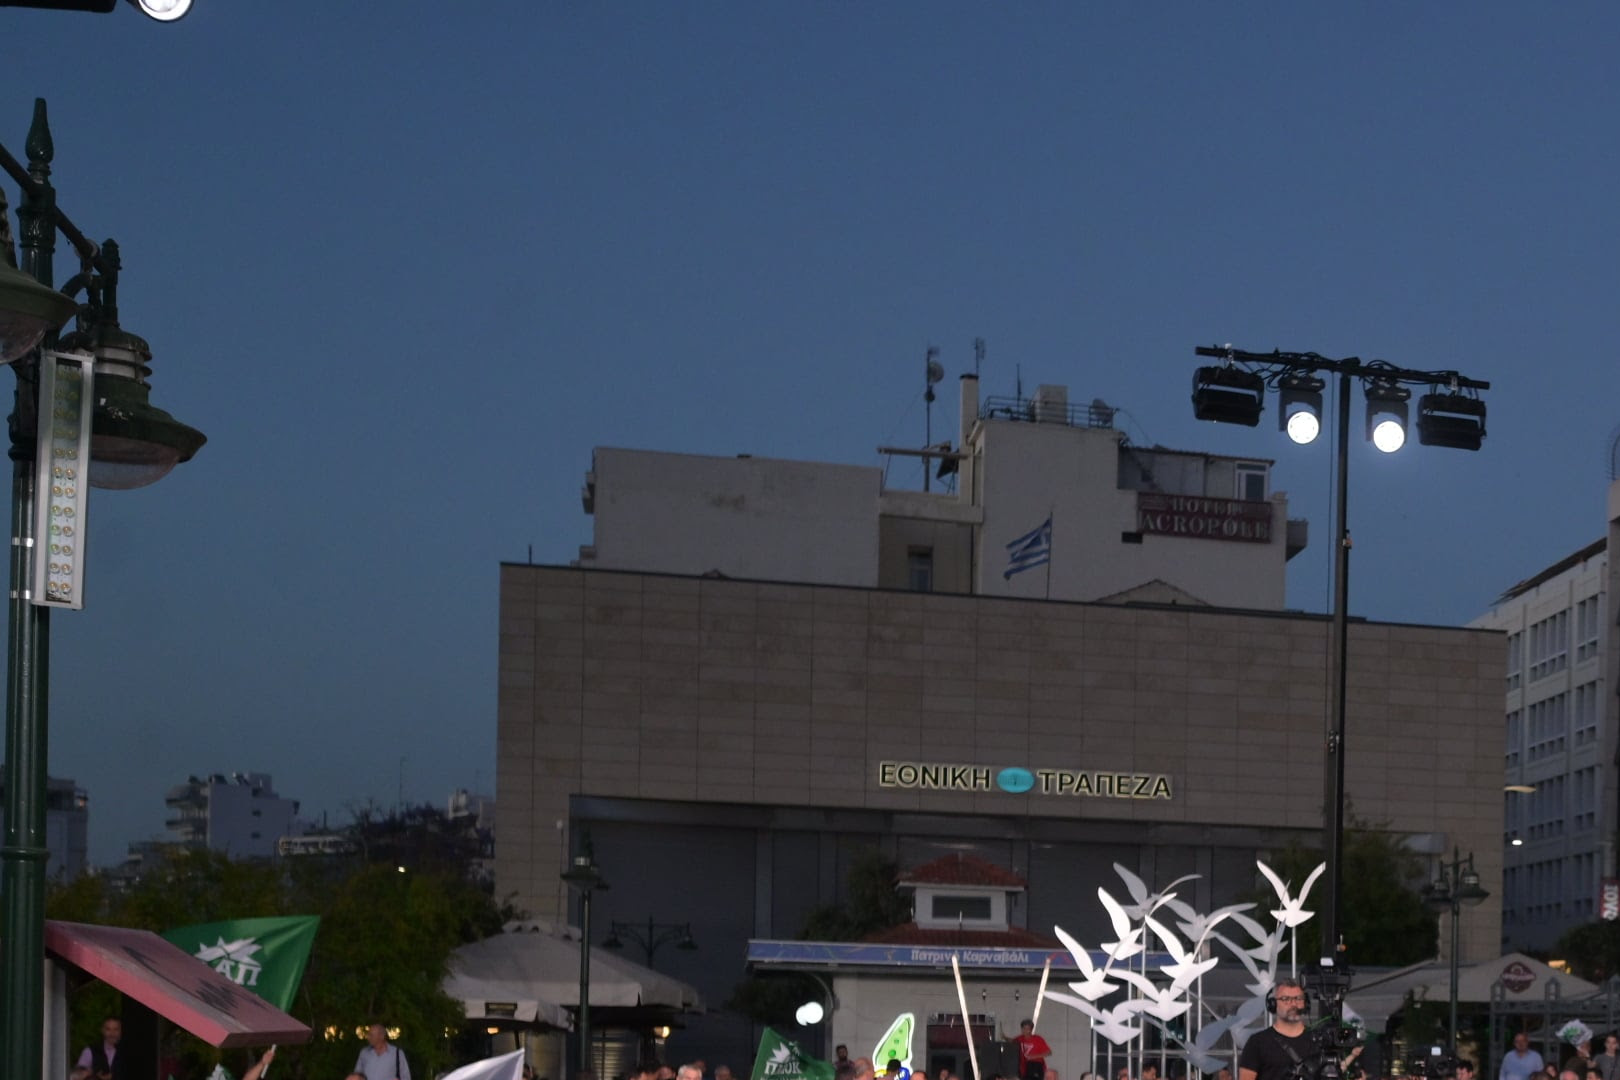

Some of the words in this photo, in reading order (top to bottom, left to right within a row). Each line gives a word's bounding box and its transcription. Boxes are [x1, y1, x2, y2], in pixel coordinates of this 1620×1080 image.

[879, 760, 991, 790] ΕΘΝΙΚΗ
[1037, 767, 1172, 799] ΤΡΑΠΕΖΑ
[963, 950, 1029, 965] Καρναβάλι
